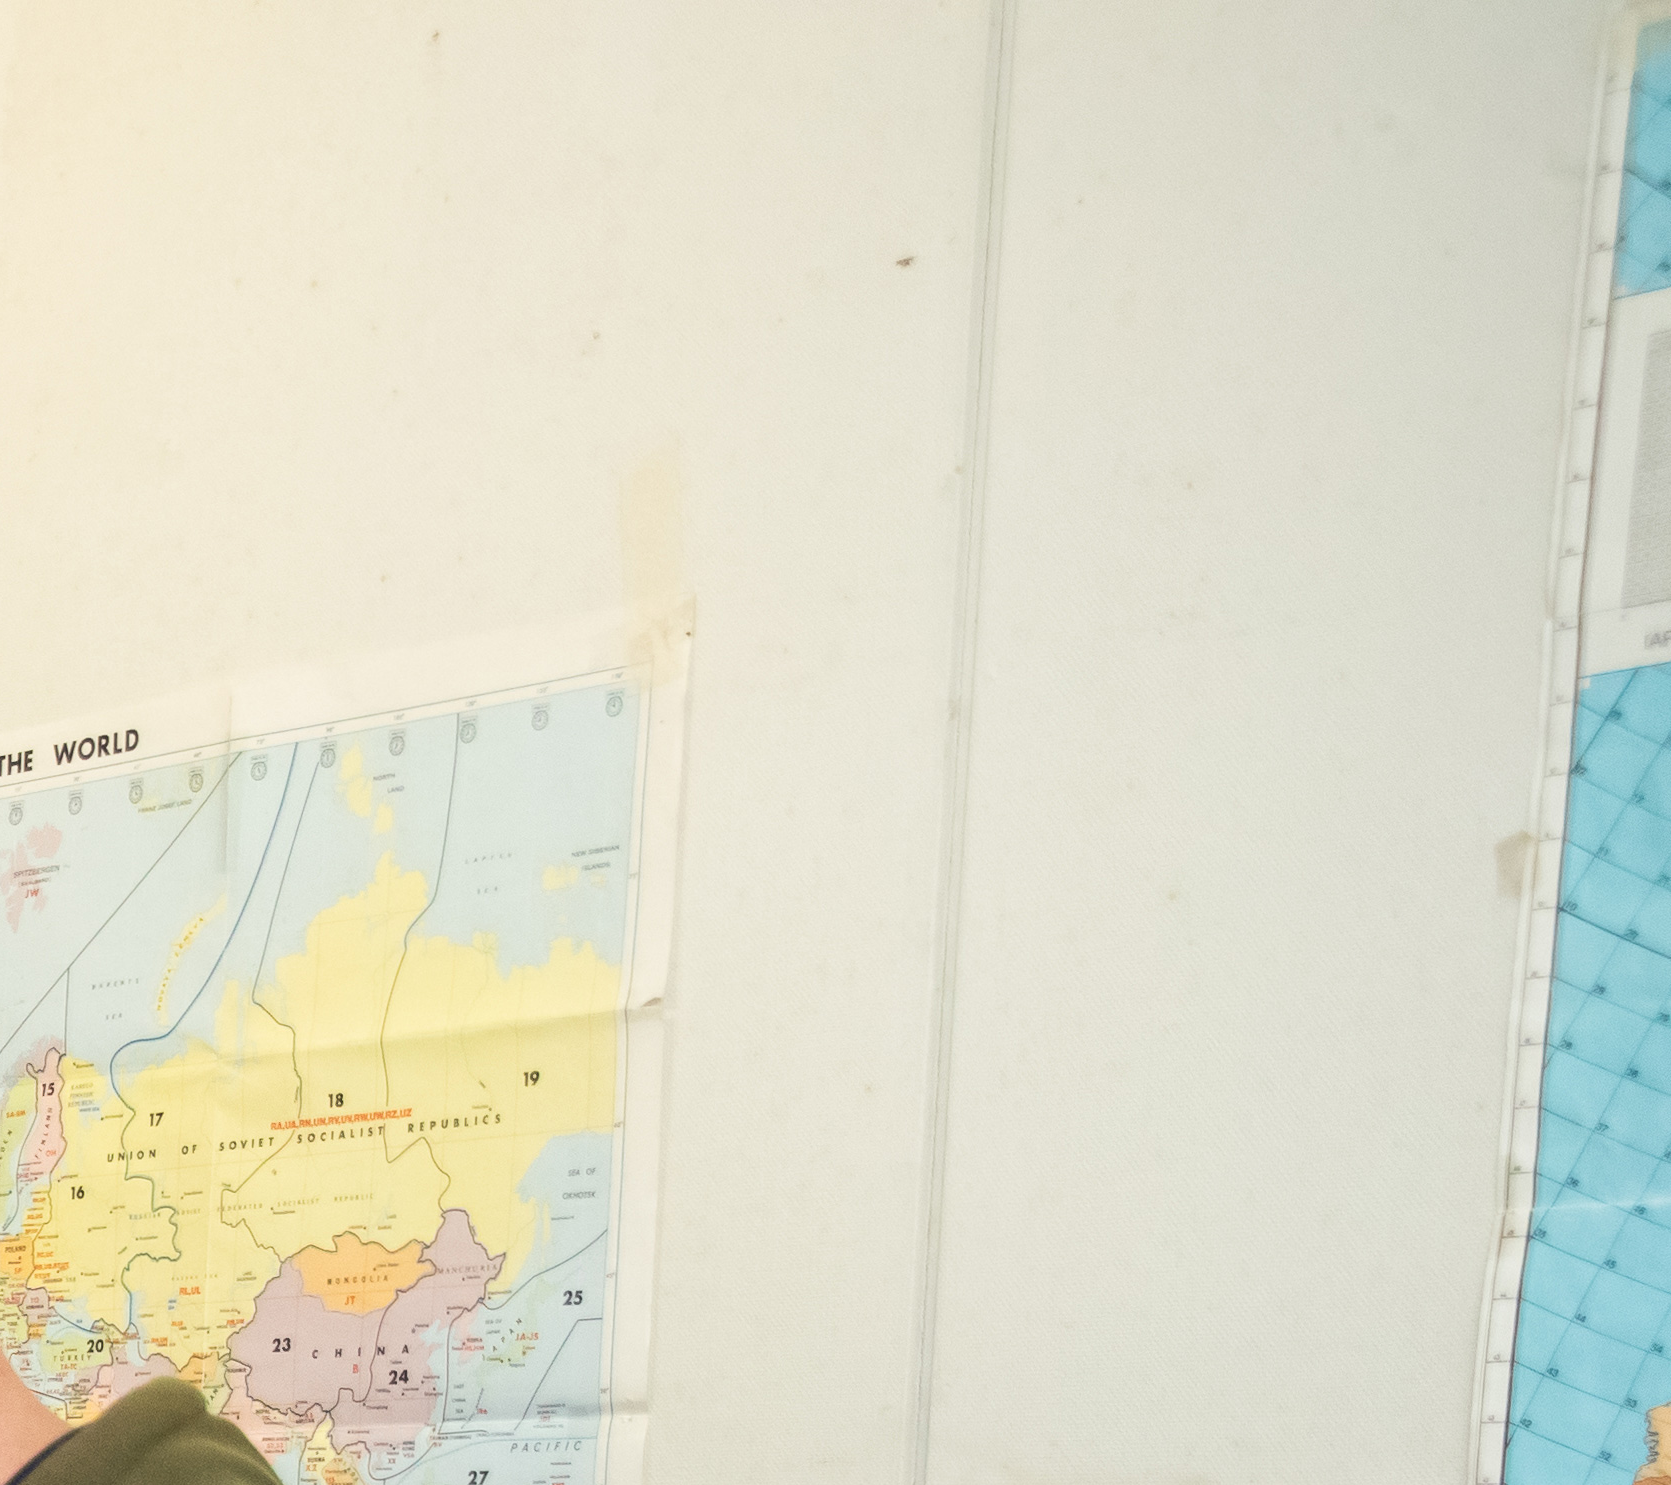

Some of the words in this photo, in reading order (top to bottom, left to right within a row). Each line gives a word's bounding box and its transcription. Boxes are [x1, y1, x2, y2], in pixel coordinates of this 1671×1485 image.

[53, 729, 140, 766] WORLD
[523, 1071, 540, 1087] 19
[42, 1082, 55, 1097] 15
[328, 1092, 345, 1108] 18
[149, 1112, 165, 1128] 17
[107, 1148, 157, 1163] UNION
[181, 1144, 198, 1155] OF
[219, 1136, 277, 1151] SOVIET
[296, 1125, 385, 1145] SOCIALIST
[407, 1113, 503, 1134] REPUBLICS
[71, 1186, 85, 1200] 16
[563, 1290, 583, 1306] 25
[86, 1339, 104, 1353] 20
[272, 1337, 292, 1353] 23
[311, 1343, 410, 1360] CHINA
[388, 1369, 409, 1386] 24
[510, 1440, 583, 1454] PACIFIC
[468, 1470, 490, 1485] 27
